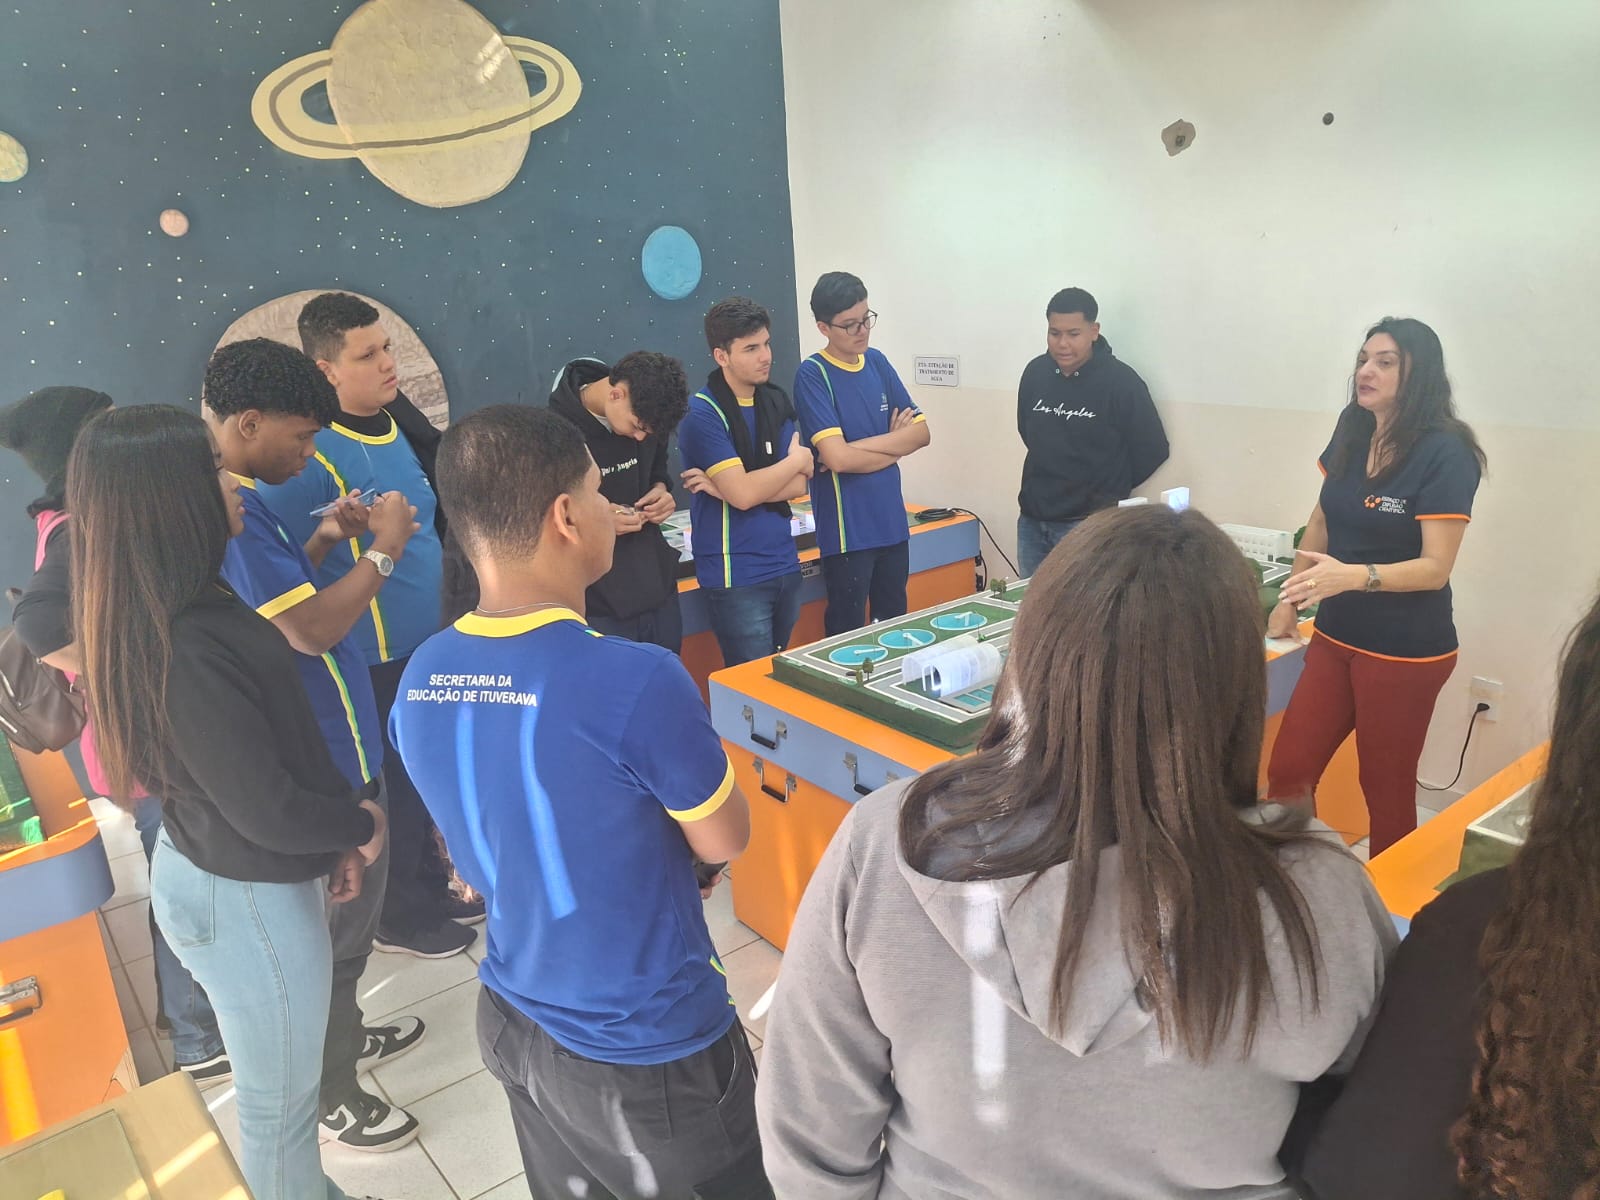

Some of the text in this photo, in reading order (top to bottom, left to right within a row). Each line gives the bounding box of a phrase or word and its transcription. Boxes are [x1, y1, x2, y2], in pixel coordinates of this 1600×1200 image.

[1032, 399, 1096, 420] Los Angeles
[616, 458, 638, 472] Angels
[429, 673, 512, 688] SECRETARIA DA
[407, 688, 538, 707] EDUCAÇÃO DE ITUVERAVA
